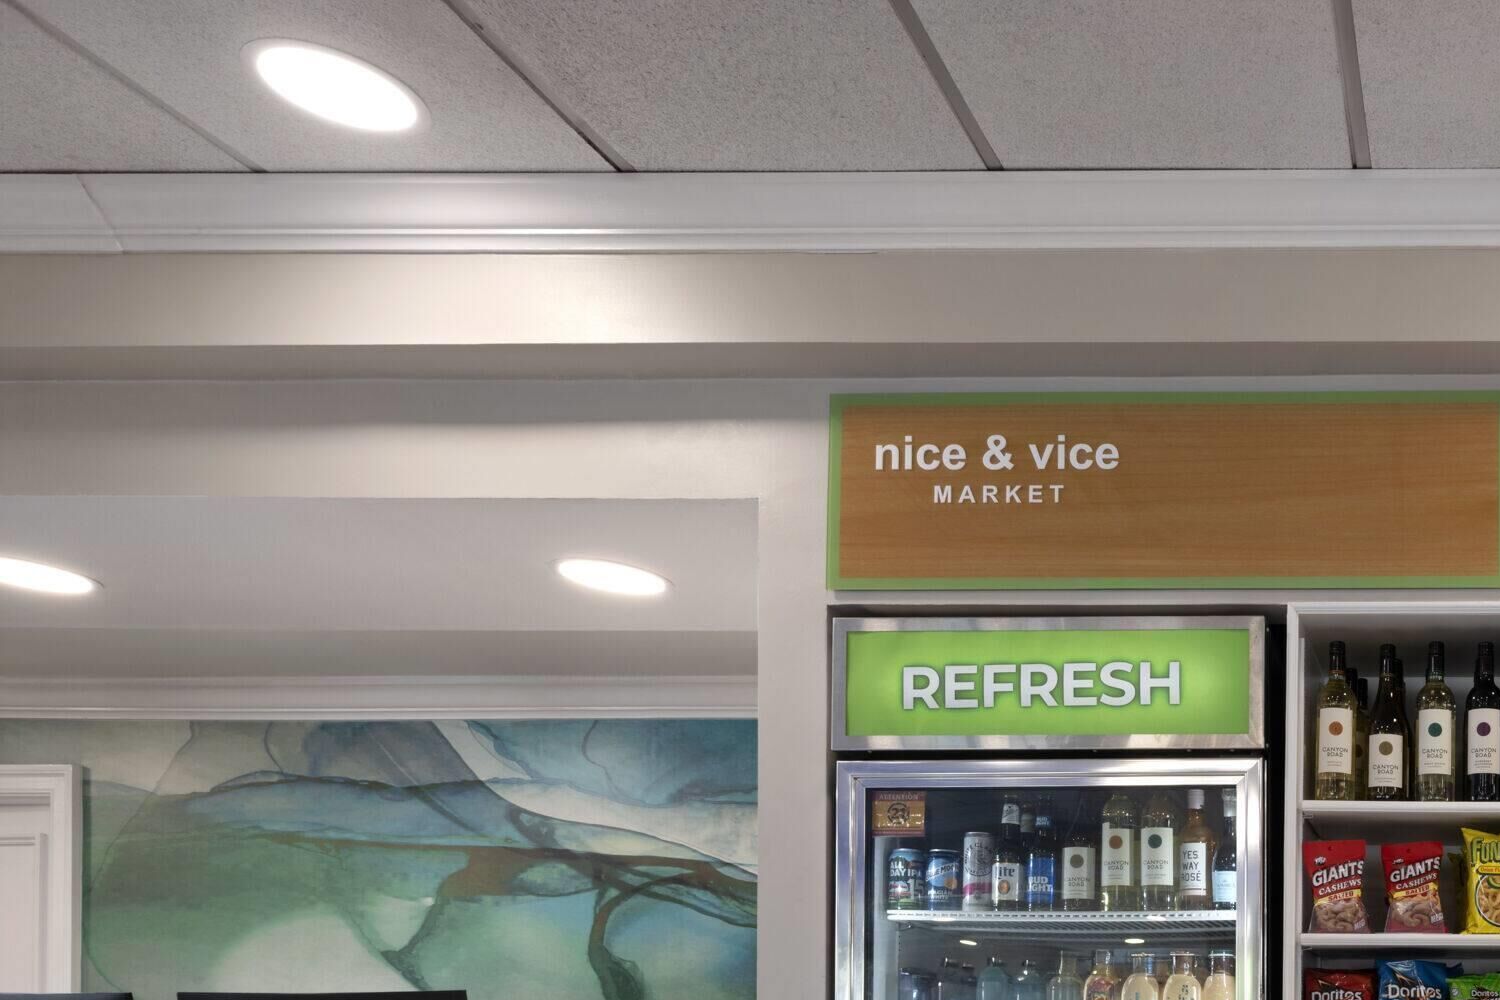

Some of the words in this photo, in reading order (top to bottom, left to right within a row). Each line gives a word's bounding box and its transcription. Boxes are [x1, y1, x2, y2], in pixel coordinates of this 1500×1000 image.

[874, 434, 967, 472] nice
[982, 434, 1015, 472] &
[1029, 434, 1120, 471] vice
[932, 485, 1066, 504] MARKET
[902, 661, 1182, 710] REFRESH
[1182, 850, 1199, 860] YES
[890, 861, 904, 869] ALL
[890, 869, 907, 877] DAY
[1182, 862, 1199, 871] WAY
[1312, 860, 1364, 887] GIANTS
[1390, 857, 1441, 883] GIANTS
[1029, 876, 1048, 884] BUD
[1318, 878, 1362, 896] CASHEWS
[1395, 872, 1438, 890] CASHEWS
[1388, 984, 1443, 1000] Doritos
